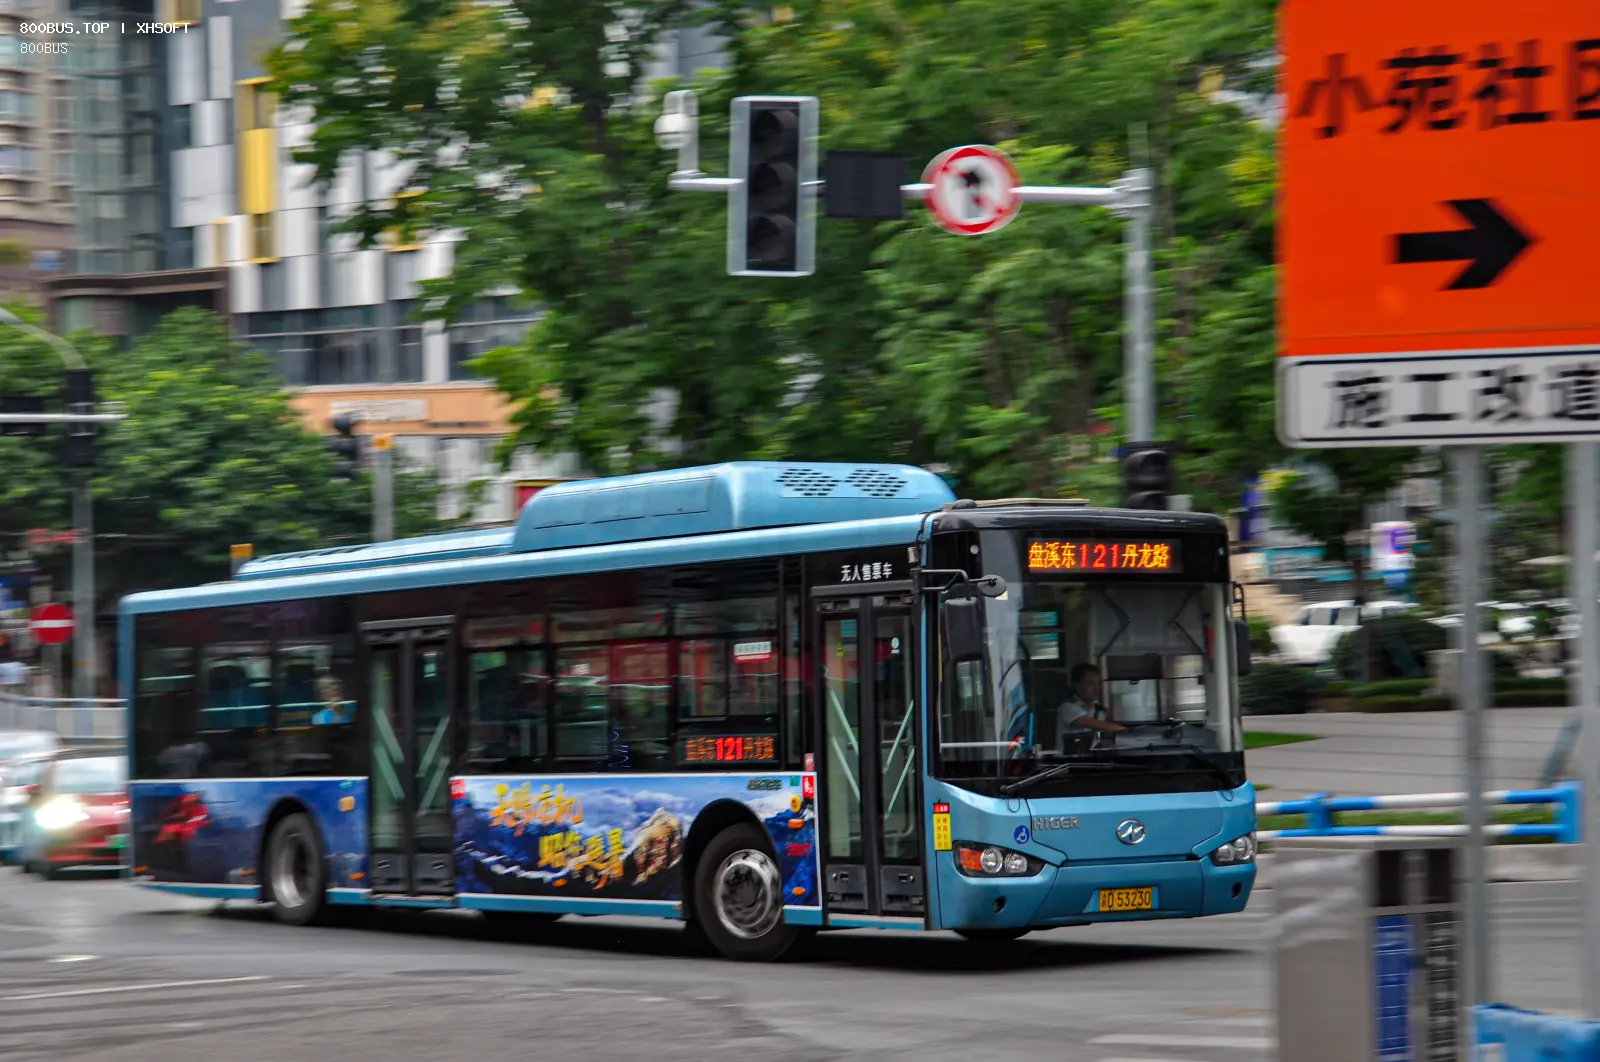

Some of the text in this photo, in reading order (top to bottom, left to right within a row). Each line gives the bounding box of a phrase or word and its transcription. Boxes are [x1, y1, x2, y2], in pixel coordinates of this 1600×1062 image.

[1079, 543, 1120, 569] 121
[1121, 542, 1170, 568] 丹龙路
[840, 561, 893, 582] 无人售票车
[715, 735, 743, 761] 121
[1032, 815, 1080, 831] HIGER
[1117, 890, 1151, 908] 53230
